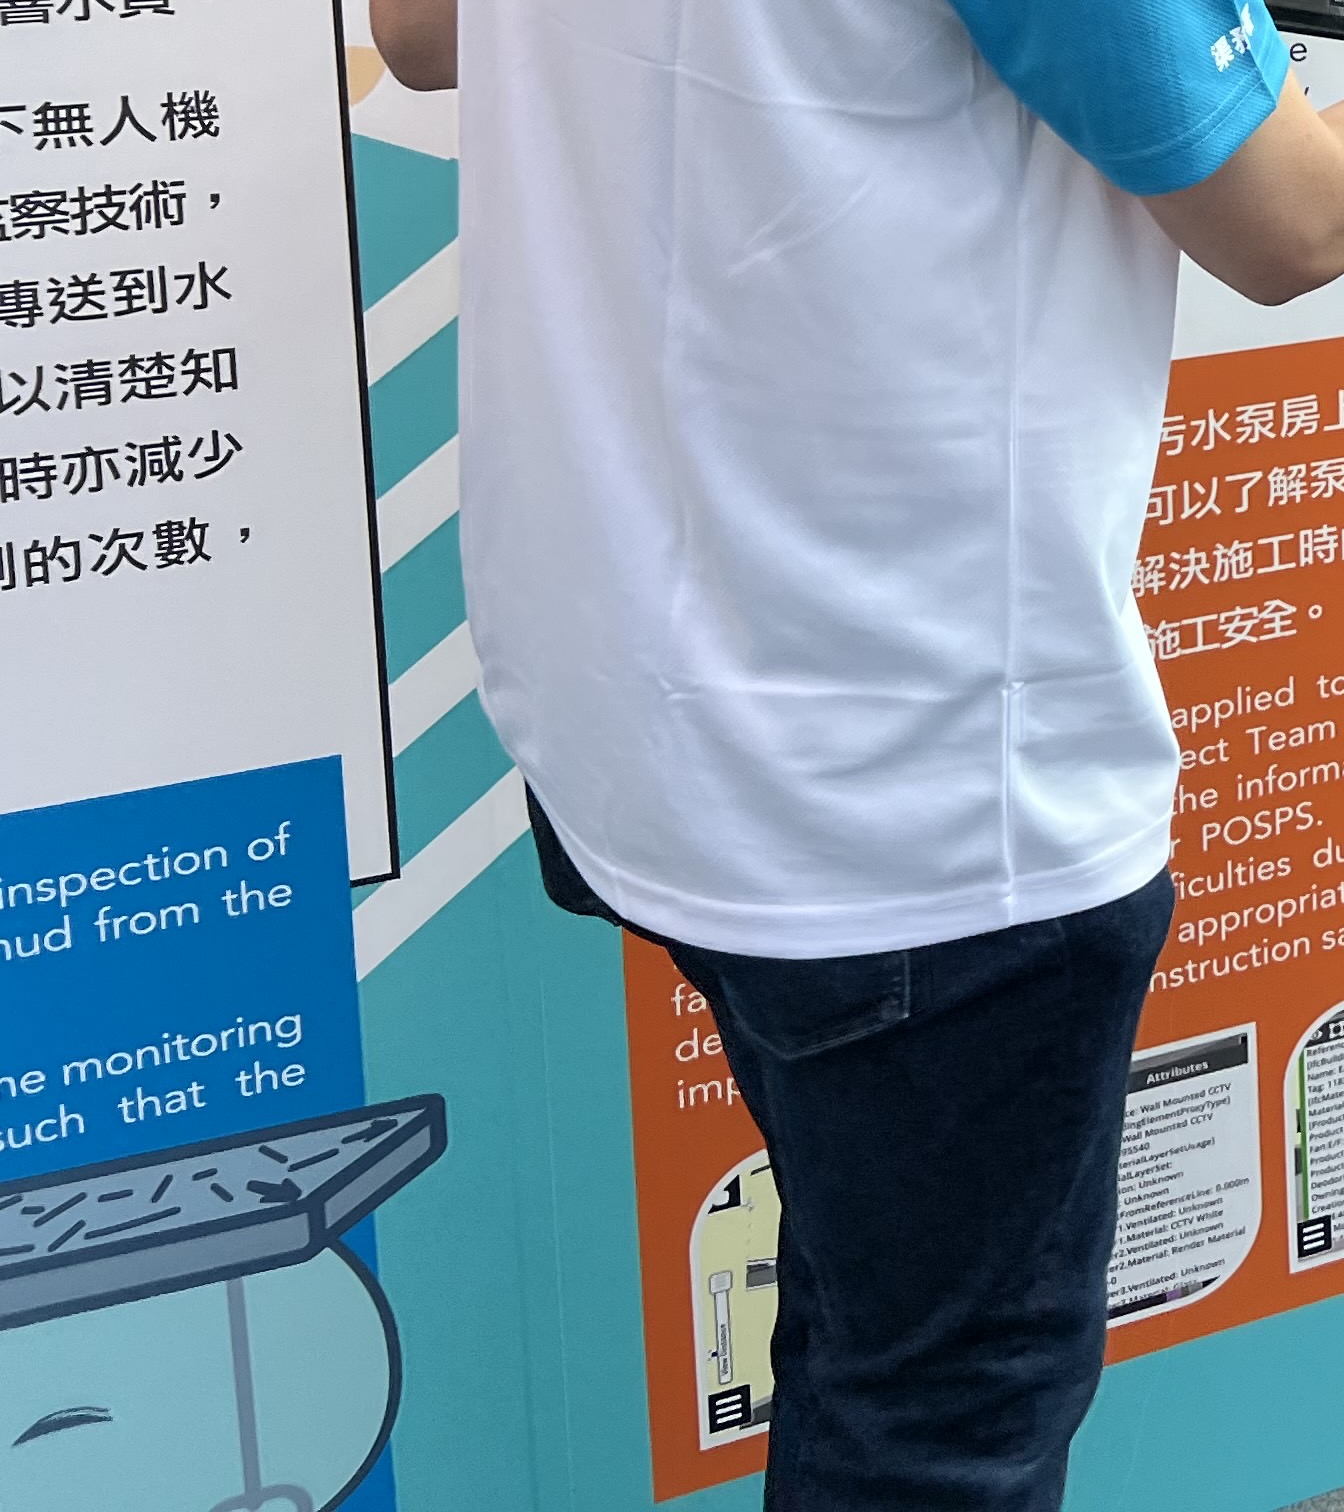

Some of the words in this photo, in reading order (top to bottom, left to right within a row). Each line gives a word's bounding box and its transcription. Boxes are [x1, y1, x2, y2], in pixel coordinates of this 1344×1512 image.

[0, 517, 254, 590] 的次數，
[1172, 676, 1295, 735] applied
[247, 820, 293, 861] of
[94, 896, 201, 945] from
[221, 877, 294, 920] the
[62, 1010, 304, 1087] monitoring
[116, 1081, 208, 1128] that
[234, 1060, 307, 1104] the
